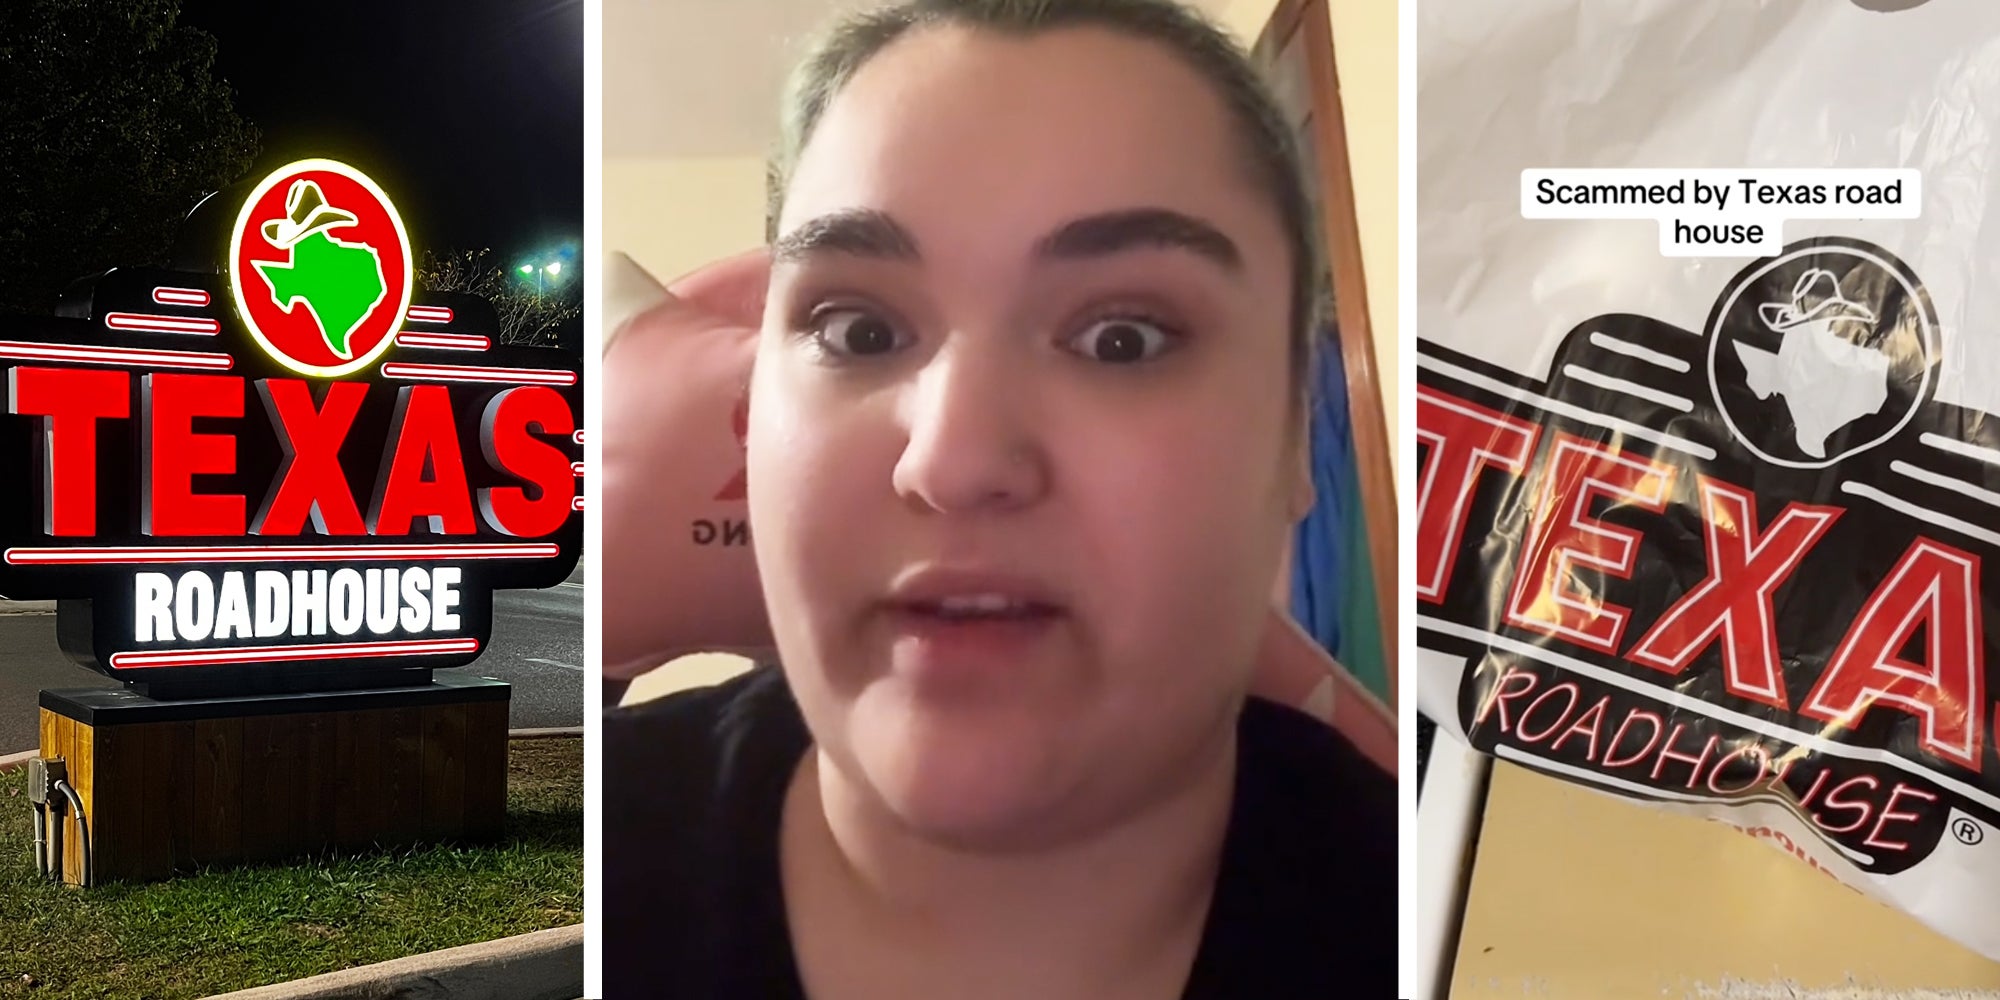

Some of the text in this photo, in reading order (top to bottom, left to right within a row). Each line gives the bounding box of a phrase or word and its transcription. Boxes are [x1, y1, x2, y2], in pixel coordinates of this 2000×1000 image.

[8, 366, 576, 538] TEXAS
[134, 565, 463, 642] ROADHOUSE
[1417, 383, 2000, 773] TEXA
[1476, 666, 1936, 850] ROADHOUSE
